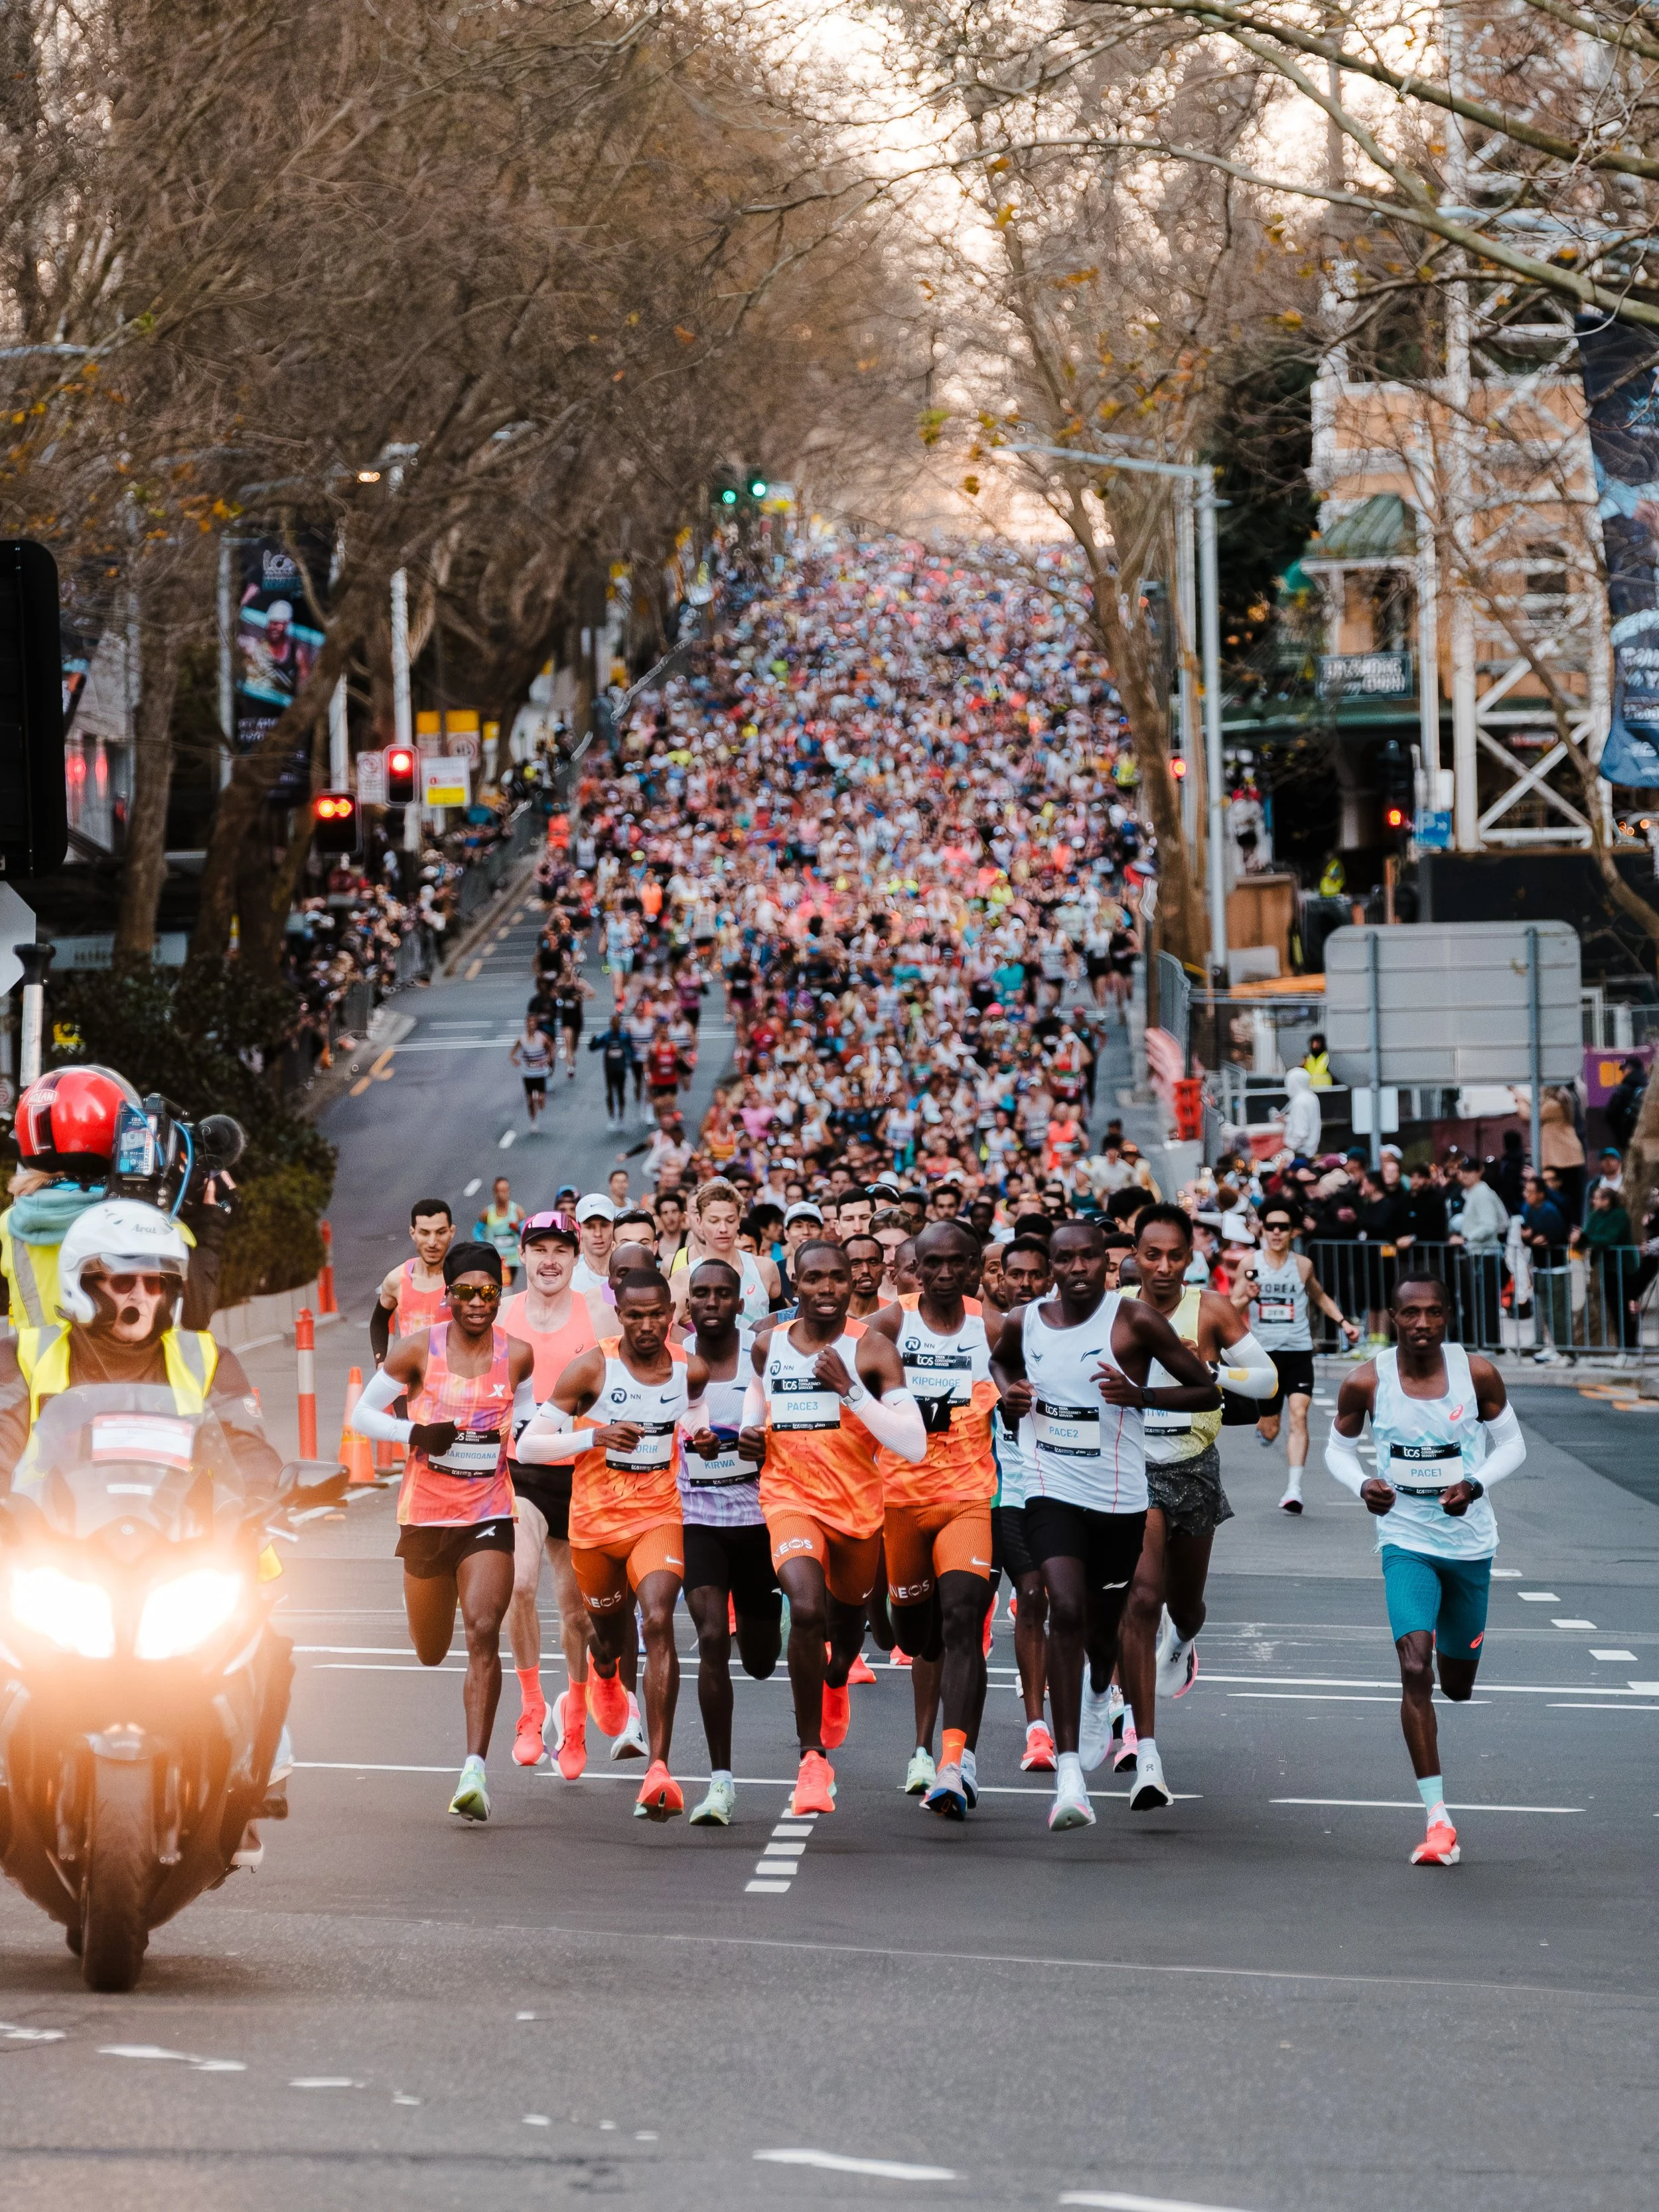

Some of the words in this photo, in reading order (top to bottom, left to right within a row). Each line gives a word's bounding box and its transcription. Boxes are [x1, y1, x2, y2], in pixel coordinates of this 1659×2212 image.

[917, 1354, 933, 1366] tcs
[782, 1379, 798, 1390] tcs
[912, 1376, 961, 1387] KIPCHOGE
[787, 1402, 818, 1411] PACE3
[1045, 1404, 1058, 1416] tcs
[1049, 1426, 1079, 1438] PACE2
[636, 1445, 658, 1453] ORIR
[1404, 1446, 1420, 1457] tcs
[705, 1459, 735, 1469] KIRWA
[1411, 1468, 1441, 1477] PACE1
